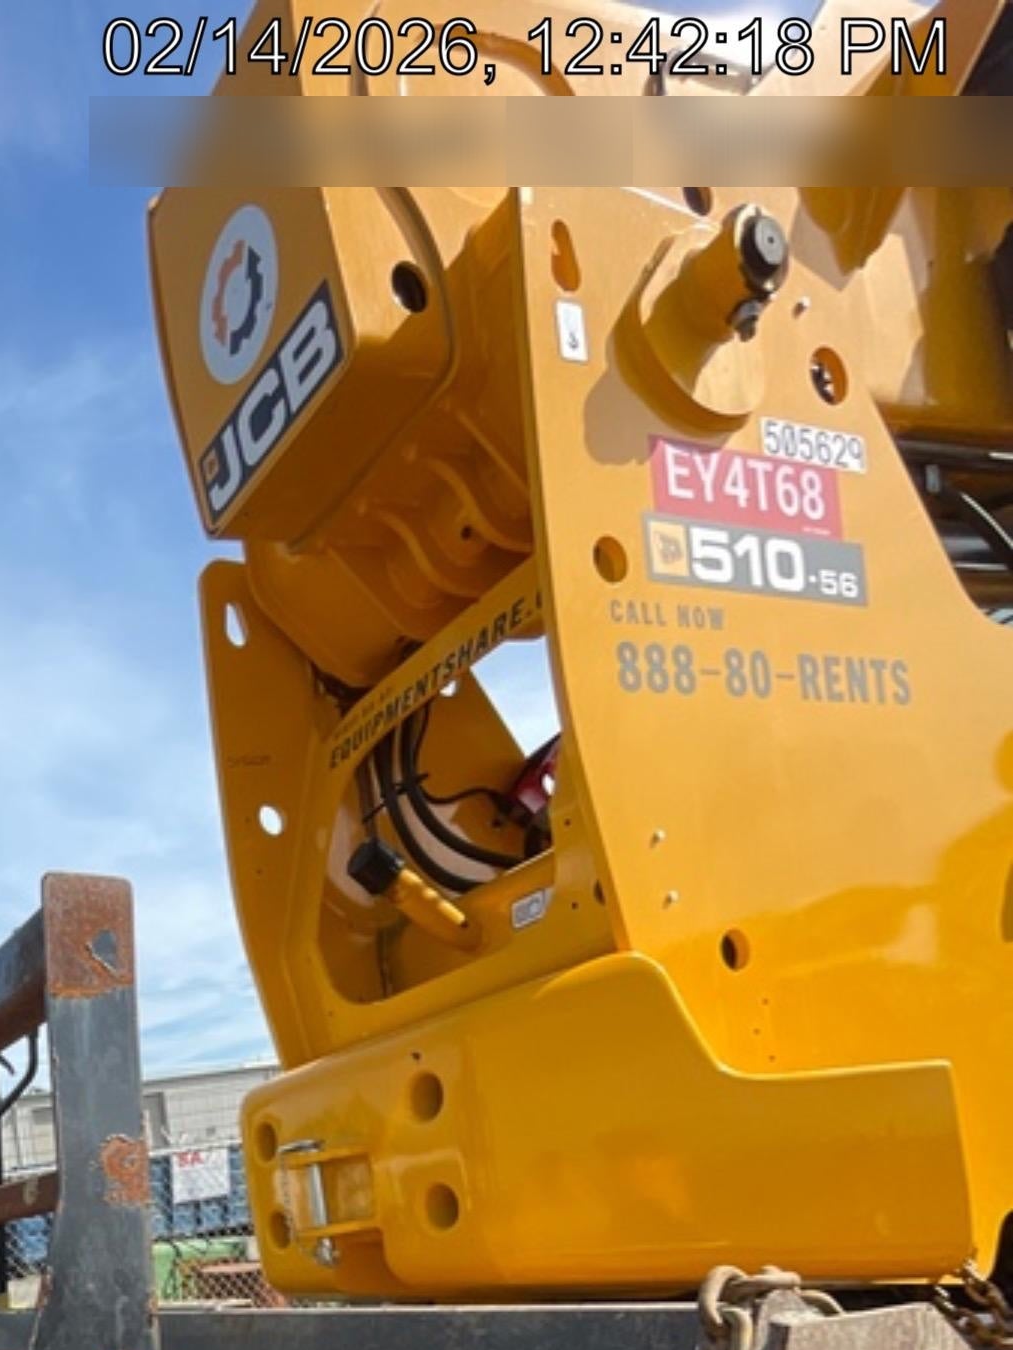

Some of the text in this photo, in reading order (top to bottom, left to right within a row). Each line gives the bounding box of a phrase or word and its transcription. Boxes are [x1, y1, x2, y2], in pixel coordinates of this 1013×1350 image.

[208, 300, 338, 512] JCB
[663, 445, 827, 521] EY4T68
[610, 599, 724, 631] CALL NOW
[616, 640, 912, 705] 888-80-RENTS
